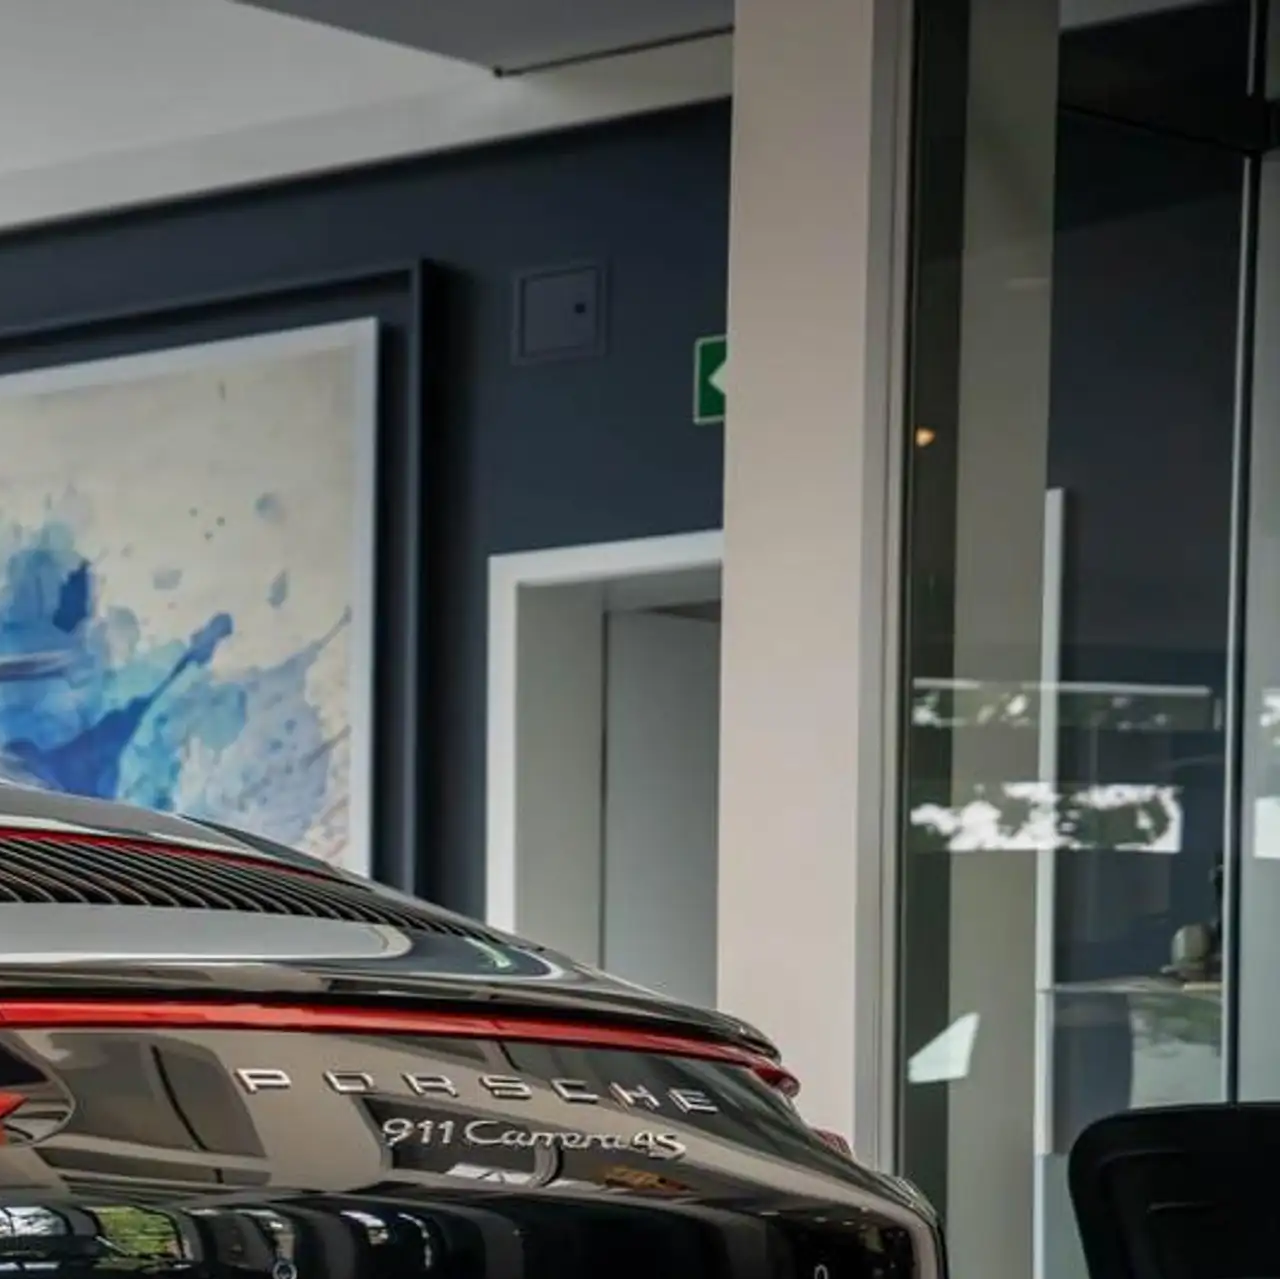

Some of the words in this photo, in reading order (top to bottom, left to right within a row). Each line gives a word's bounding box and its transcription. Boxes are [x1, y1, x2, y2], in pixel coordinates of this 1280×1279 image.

[235, 1067, 720, 1115] PORSCHE
[382, 1117, 454, 1147] 911
[464, 1120, 626, 1150] Carrera
[630, 1130, 687, 1160] 4S
